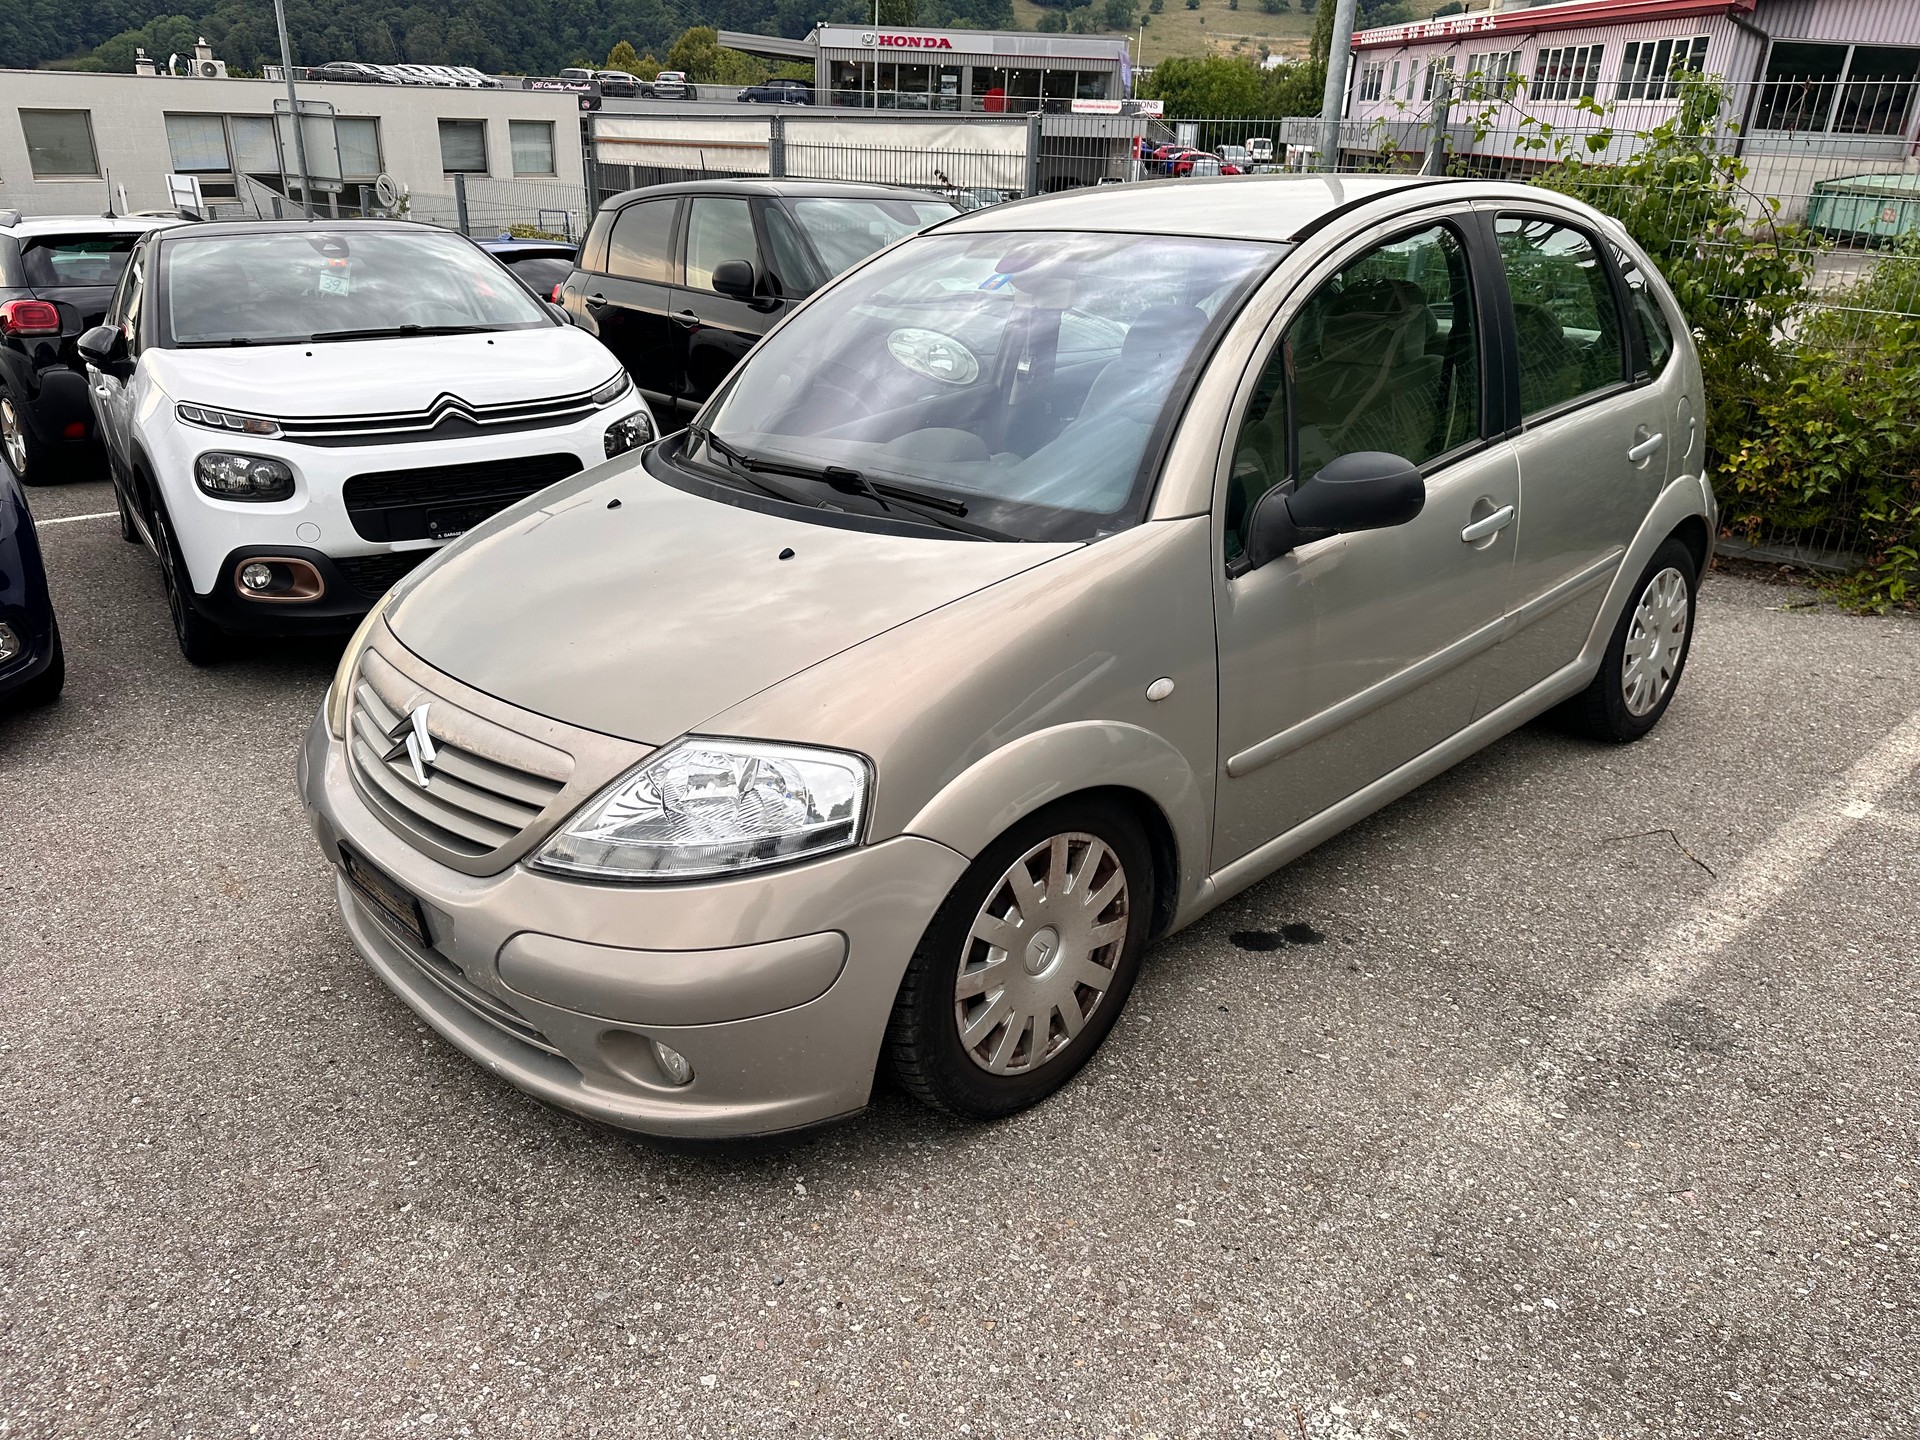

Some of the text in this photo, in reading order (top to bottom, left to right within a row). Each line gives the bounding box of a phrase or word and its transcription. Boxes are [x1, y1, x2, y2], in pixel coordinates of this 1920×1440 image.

[879, 35, 952, 49] HONDA
[1361, 28, 1404, 45] CARROSSERIE
[1408, 26, 1420, 39] DU
[1423, 23, 1446, 37] ROND
[1450, 19, 1476, 33] POINT
